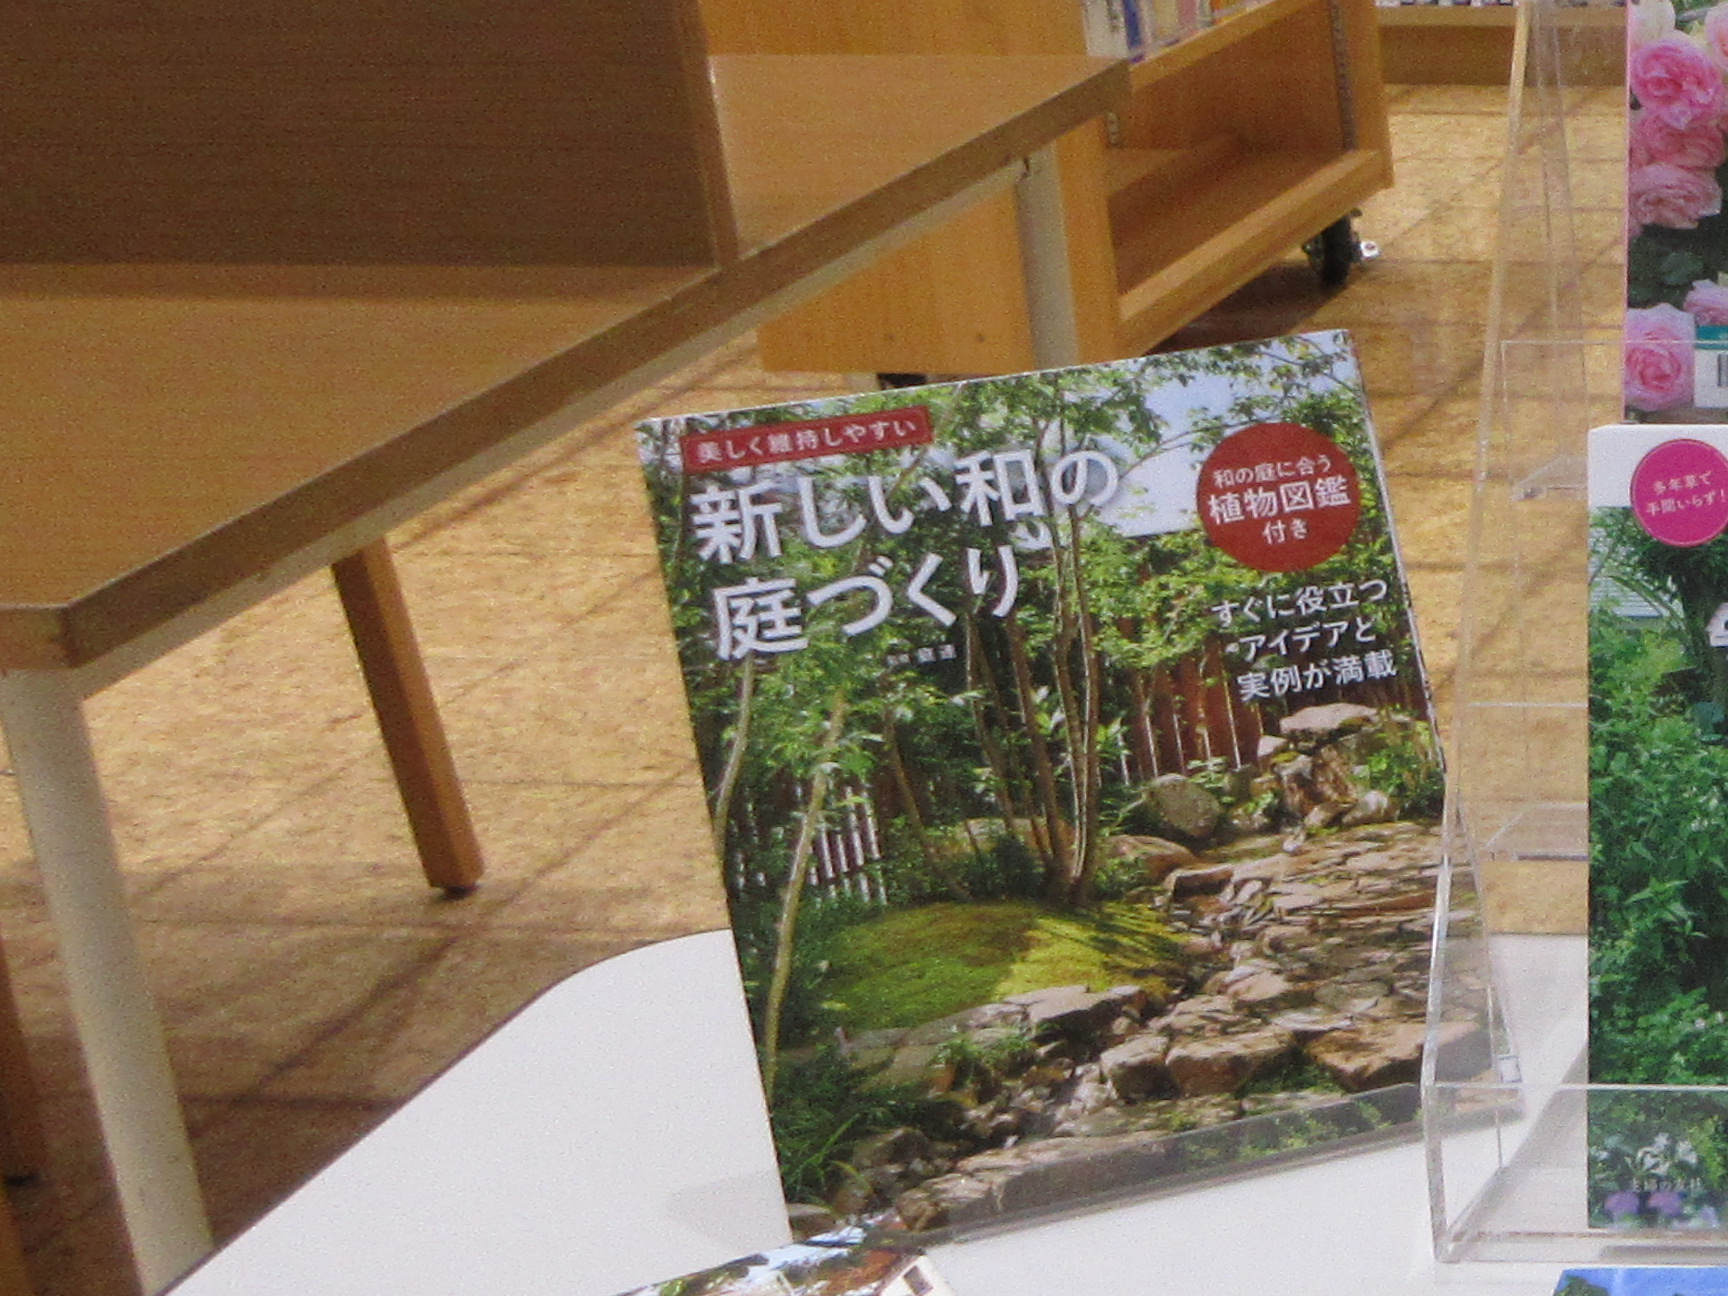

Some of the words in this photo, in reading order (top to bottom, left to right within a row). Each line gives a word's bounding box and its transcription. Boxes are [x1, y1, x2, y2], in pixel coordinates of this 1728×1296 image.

[696, 416, 921, 464] 美しく維持しやすい
[1212, 454, 1333, 489] 和の庭に合う
[688, 447, 1121, 565] 新しい和の
[1207, 483, 1353, 525] 植物図鑑
[1262, 518, 1309, 546] 付き
[712, 545, 1021, 661] 庭づくり
[1212, 576, 1389, 630] すぐに役立つ
[1236, 617, 1378, 657] アイデアと
[1235, 650, 1399, 704] 実例が満載
